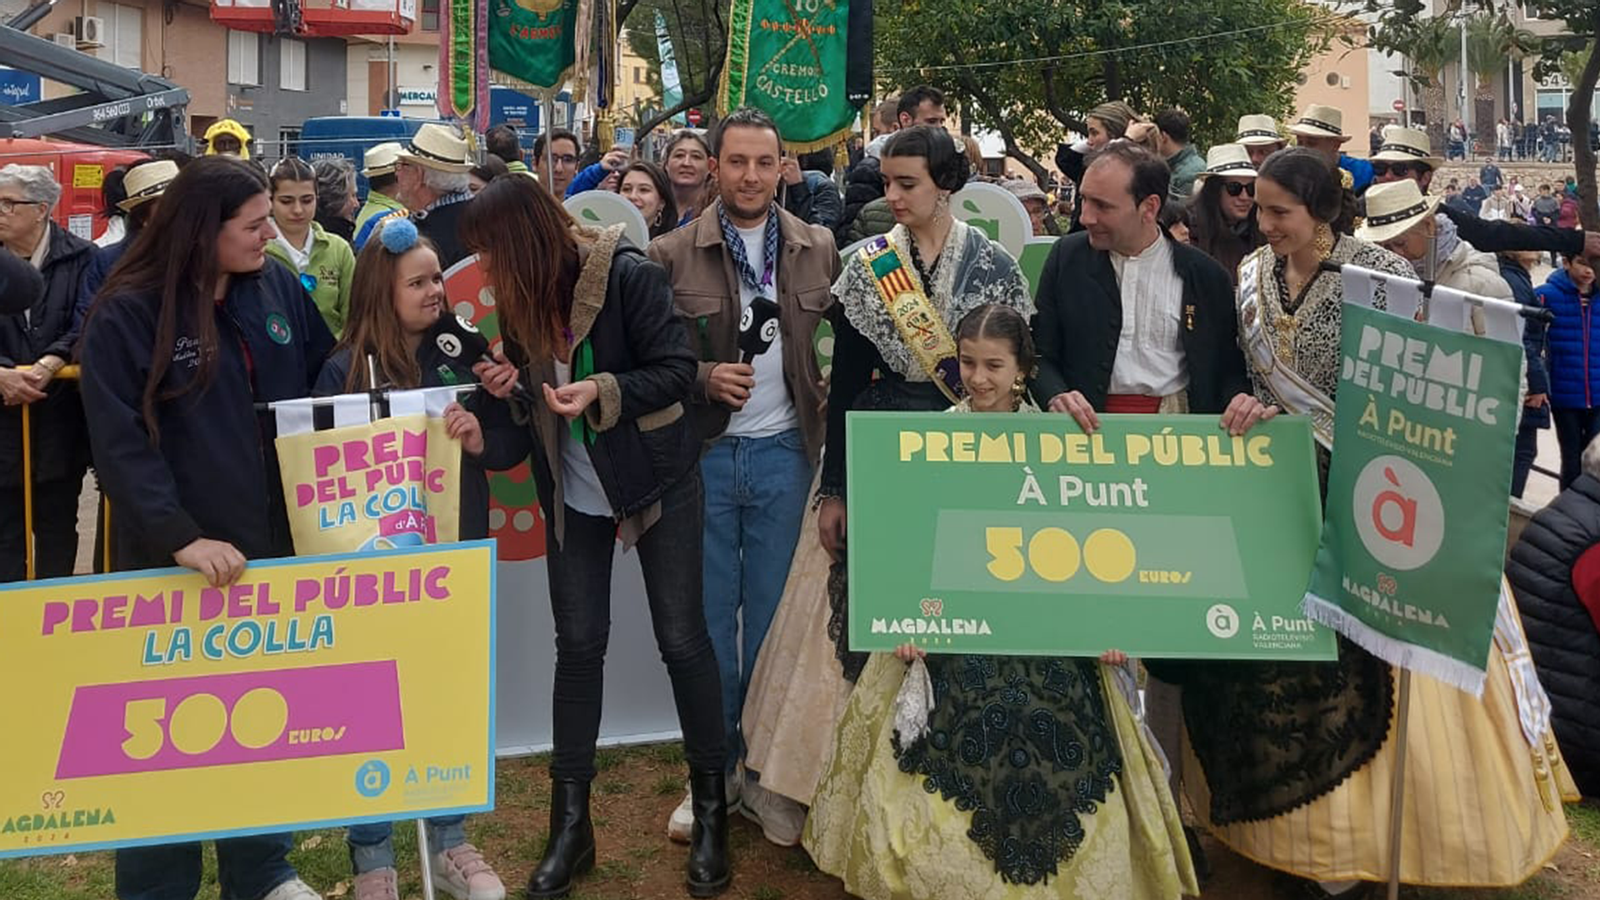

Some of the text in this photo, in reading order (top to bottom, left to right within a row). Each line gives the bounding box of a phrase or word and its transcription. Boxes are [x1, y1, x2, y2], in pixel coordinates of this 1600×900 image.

[897, 298, 920, 317] 2024
[1342, 355, 1384, 393] DEL
[1358, 324, 1483, 391] PREMI
[899, 428, 1274, 467] PREMI DEL PÚBLIC
[1359, 393, 1379, 430] À
[1387, 408, 1457, 455] Punt
[296, 458, 446, 508] DEL PÚBC
[1016, 466, 1149, 507] À Punt
[320, 485, 427, 530] LA COL
[395, 511, 418, 529] d'À
[1372, 466, 1418, 548] à
[985, 526, 1192, 584] 500 EUROS
[42, 566, 451, 635] PREMI DEL PÚBLIC
[1252, 611, 1315, 631] À Punt
[1342, 572, 1450, 628] MAGDALENA
[142, 614, 335, 666] LA COLLA
[870, 616, 993, 635] MAGDALENA
[121, 687, 347, 760] 500 EUROS
[405, 764, 471, 783] À Punt
